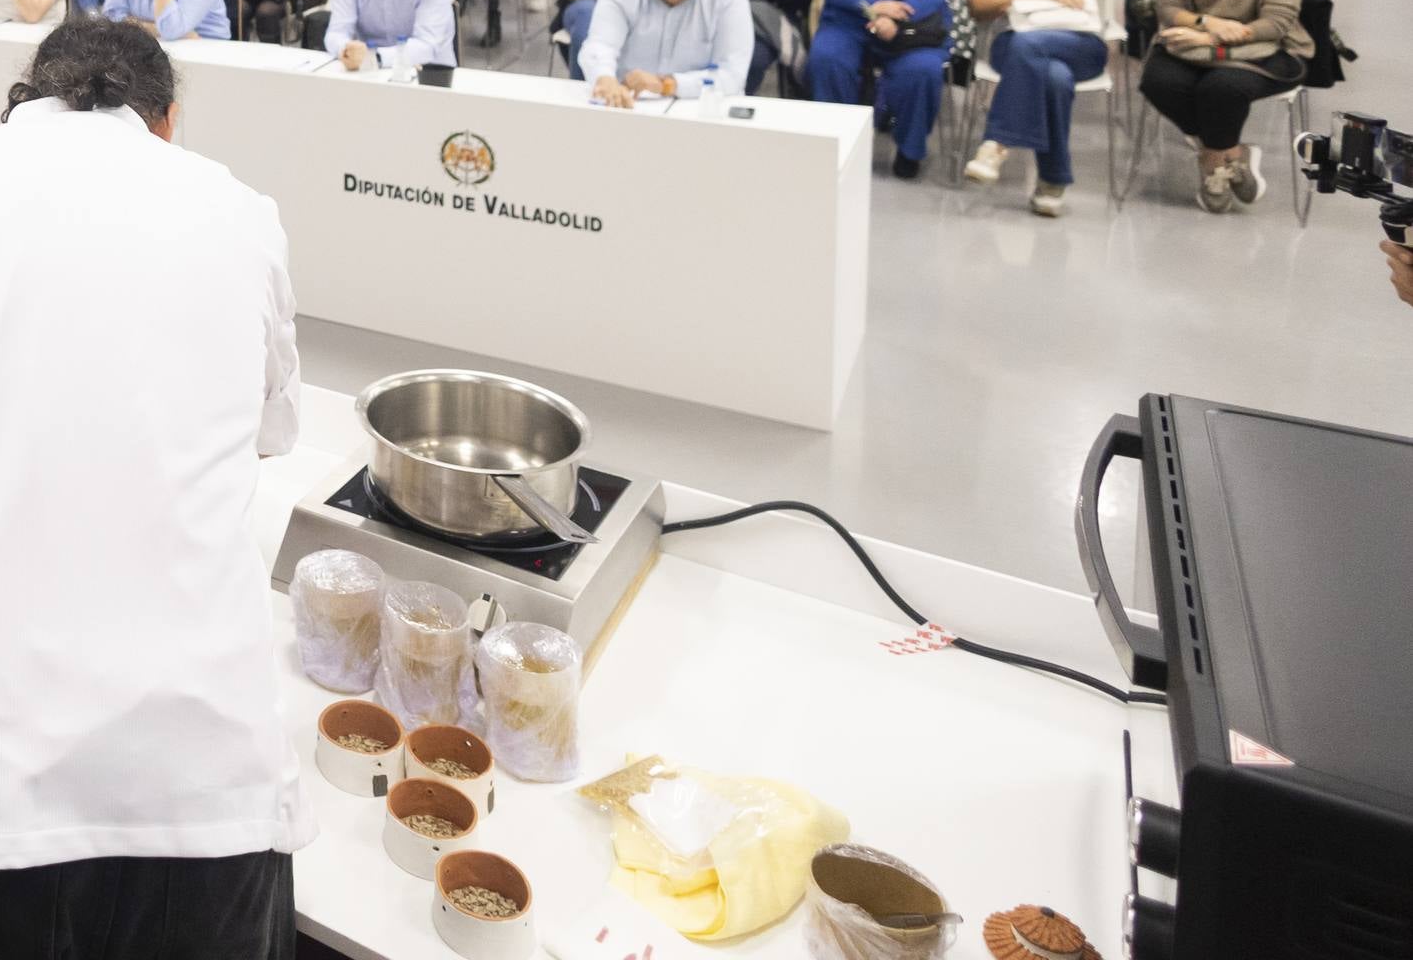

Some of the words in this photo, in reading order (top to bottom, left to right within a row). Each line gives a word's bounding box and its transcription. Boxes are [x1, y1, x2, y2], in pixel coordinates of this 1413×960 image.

[343, 173, 444, 207] DIPUTACIÓN
[452, 195, 476, 212] DE
[484, 194, 603, 232] VALLADOLID
